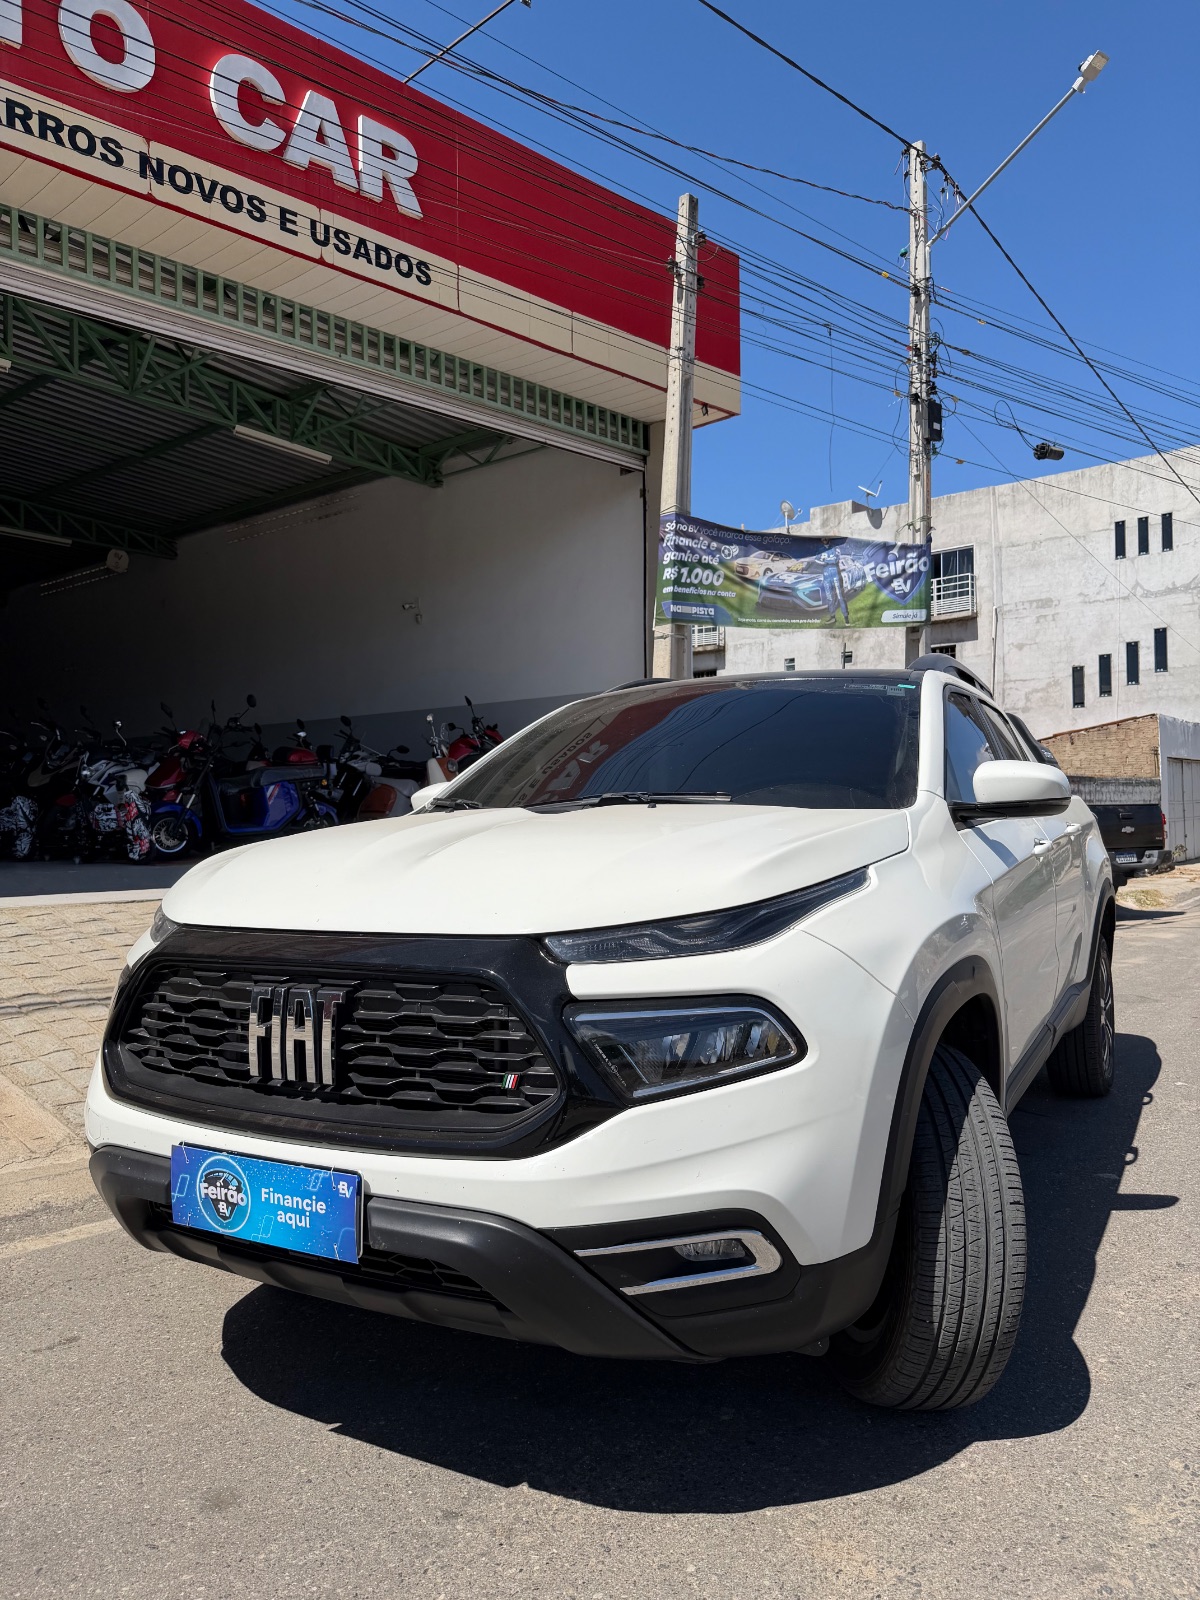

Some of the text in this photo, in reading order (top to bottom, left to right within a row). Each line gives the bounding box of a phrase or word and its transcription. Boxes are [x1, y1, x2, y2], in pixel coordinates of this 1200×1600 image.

[209, 53, 424, 220] CAR
[0, 96, 433, 286] RROS NOVOS E USADOS
[676, 523, 688, 531] no
[688, 524, 700, 533] BV
[700, 527, 718, 537] você
[718, 530, 744, 540] marca
[744, 534, 761, 542] esse
[709, 541, 718, 551] e
[663, 550, 720, 565] ganhe até
[863, 552, 929, 582] Feirão
[681, 567, 724, 586] 1.000
[716, 591, 737, 599] conta
[249, 983, 348, 1085] FIAT
[200, 1182, 248, 1207] Feirão
[261, 1187, 327, 1215] Financie
[276, 1209, 311, 1229] aqui
